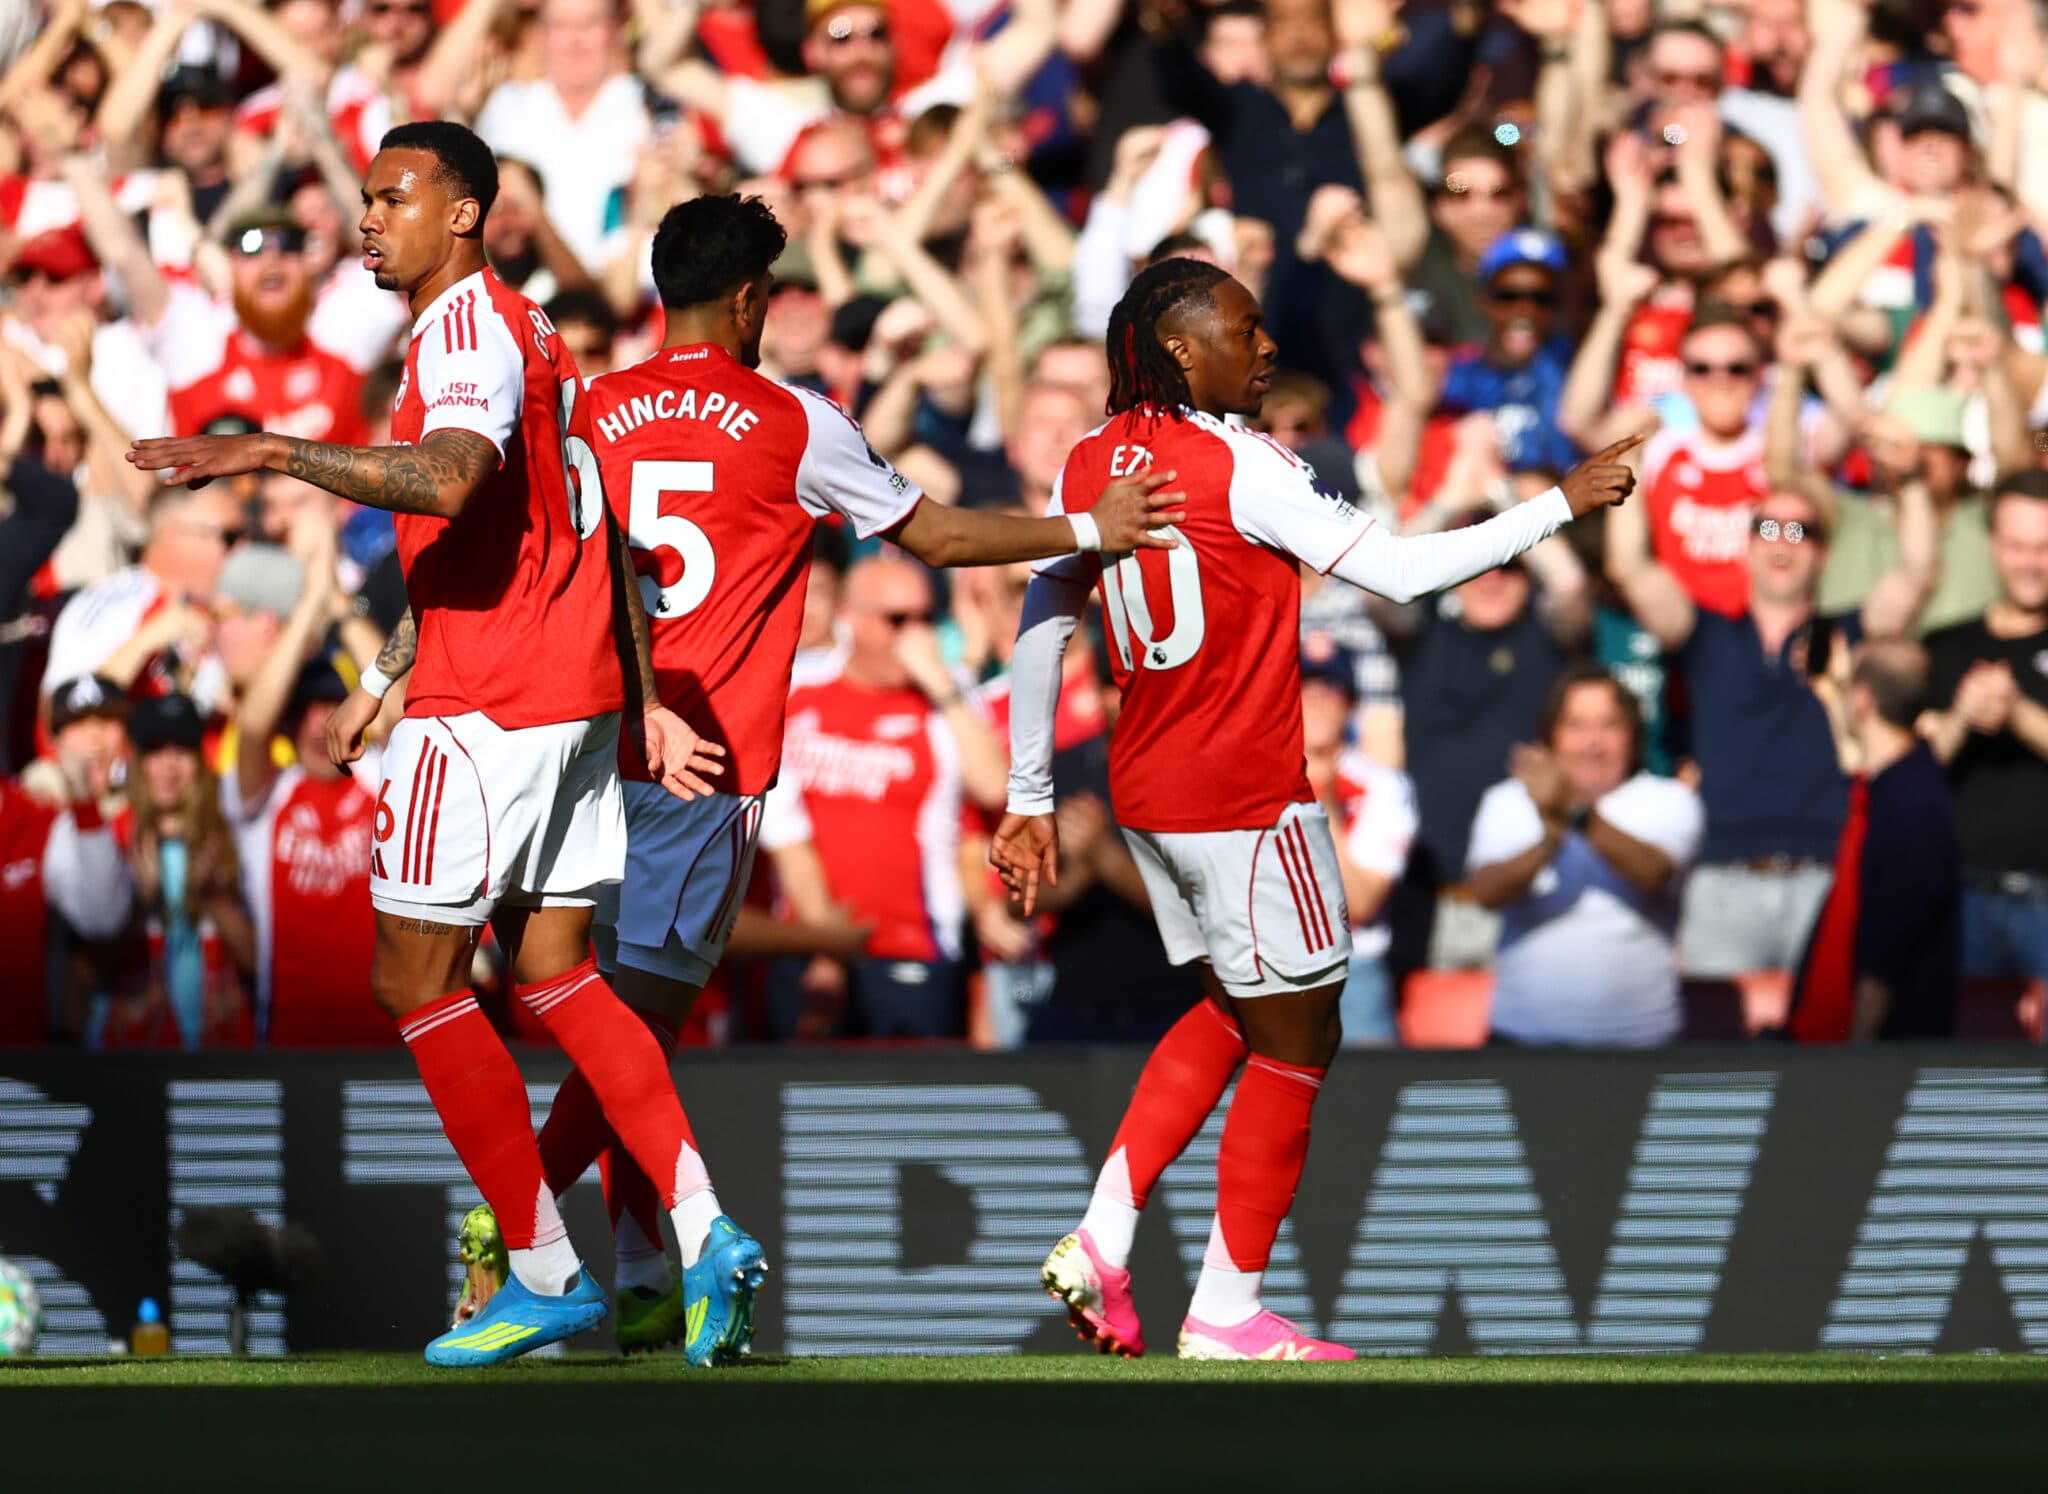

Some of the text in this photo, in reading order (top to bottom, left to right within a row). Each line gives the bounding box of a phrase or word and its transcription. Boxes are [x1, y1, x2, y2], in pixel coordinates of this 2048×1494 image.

[596, 389, 760, 443] HINCAPIE
[627, 460, 716, 619] 5
[1102, 524, 1206, 671] 10
[374, 778, 395, 843] 6
